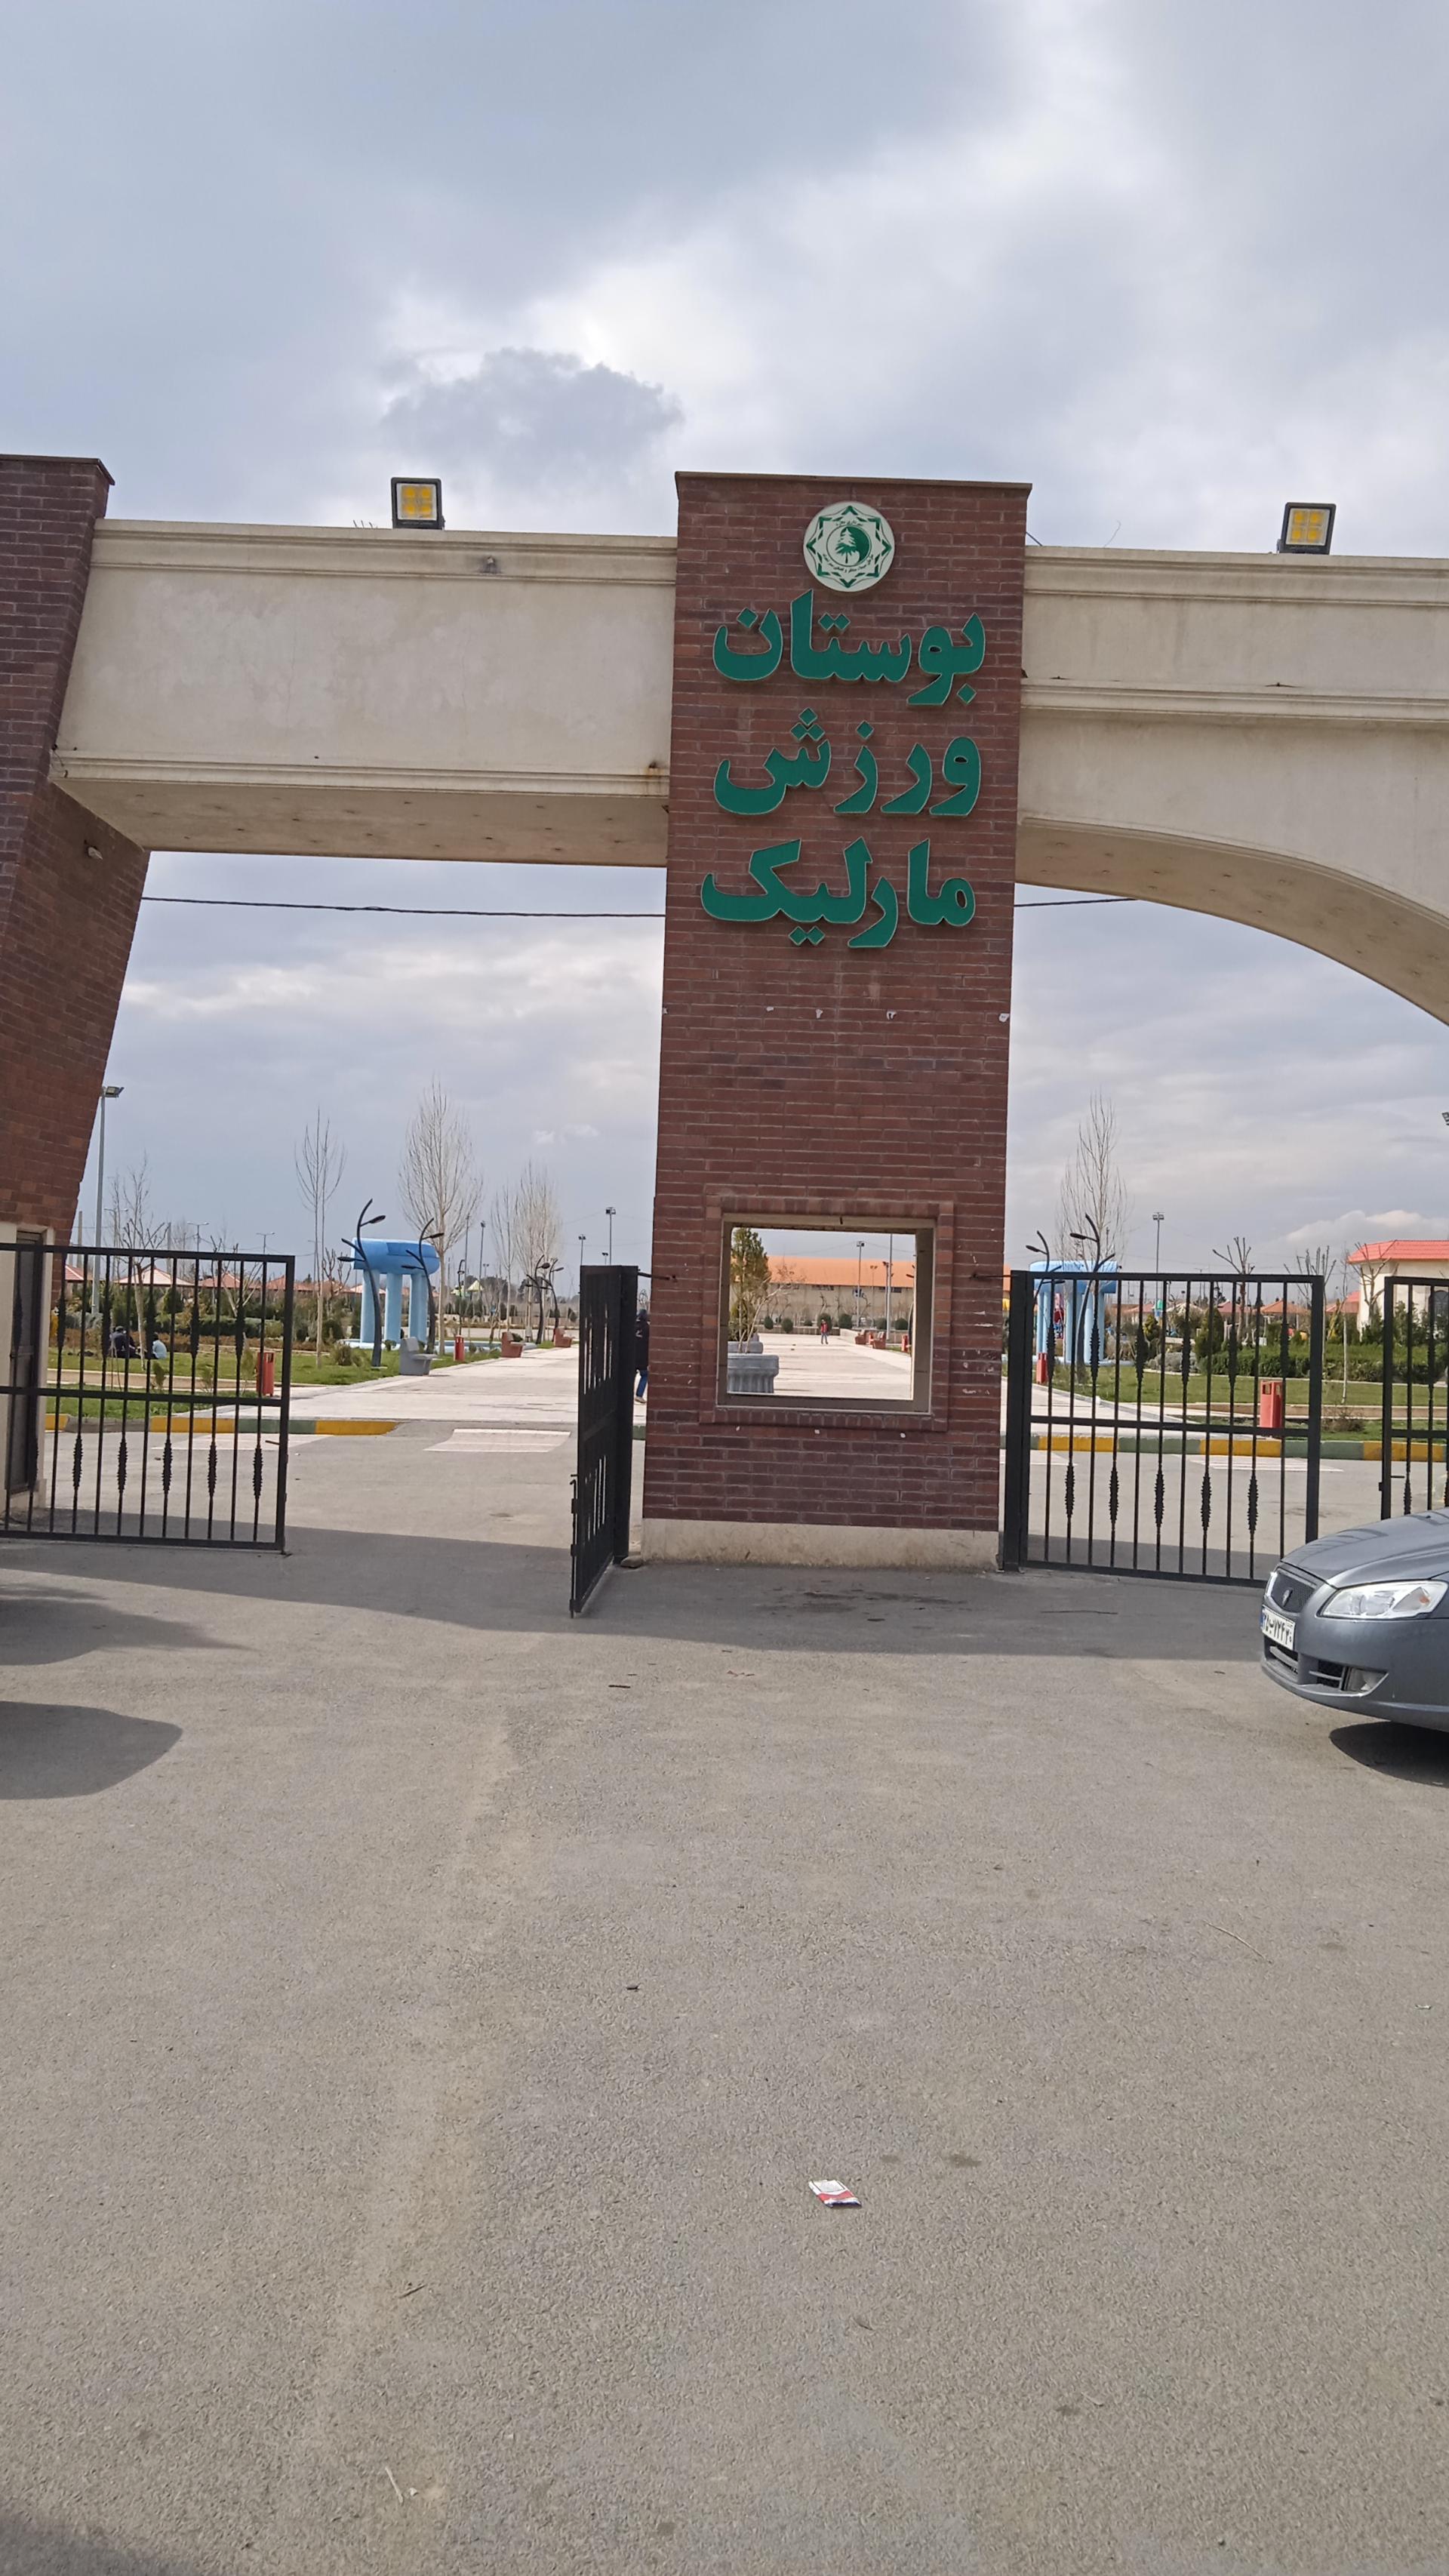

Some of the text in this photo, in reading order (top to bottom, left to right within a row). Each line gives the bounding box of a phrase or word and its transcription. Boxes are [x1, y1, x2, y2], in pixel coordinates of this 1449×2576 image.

[712, 588, 986, 706] بوستان
[712, 707, 982, 816] ورزش
[700, 837, 976, 949] مارلیک
